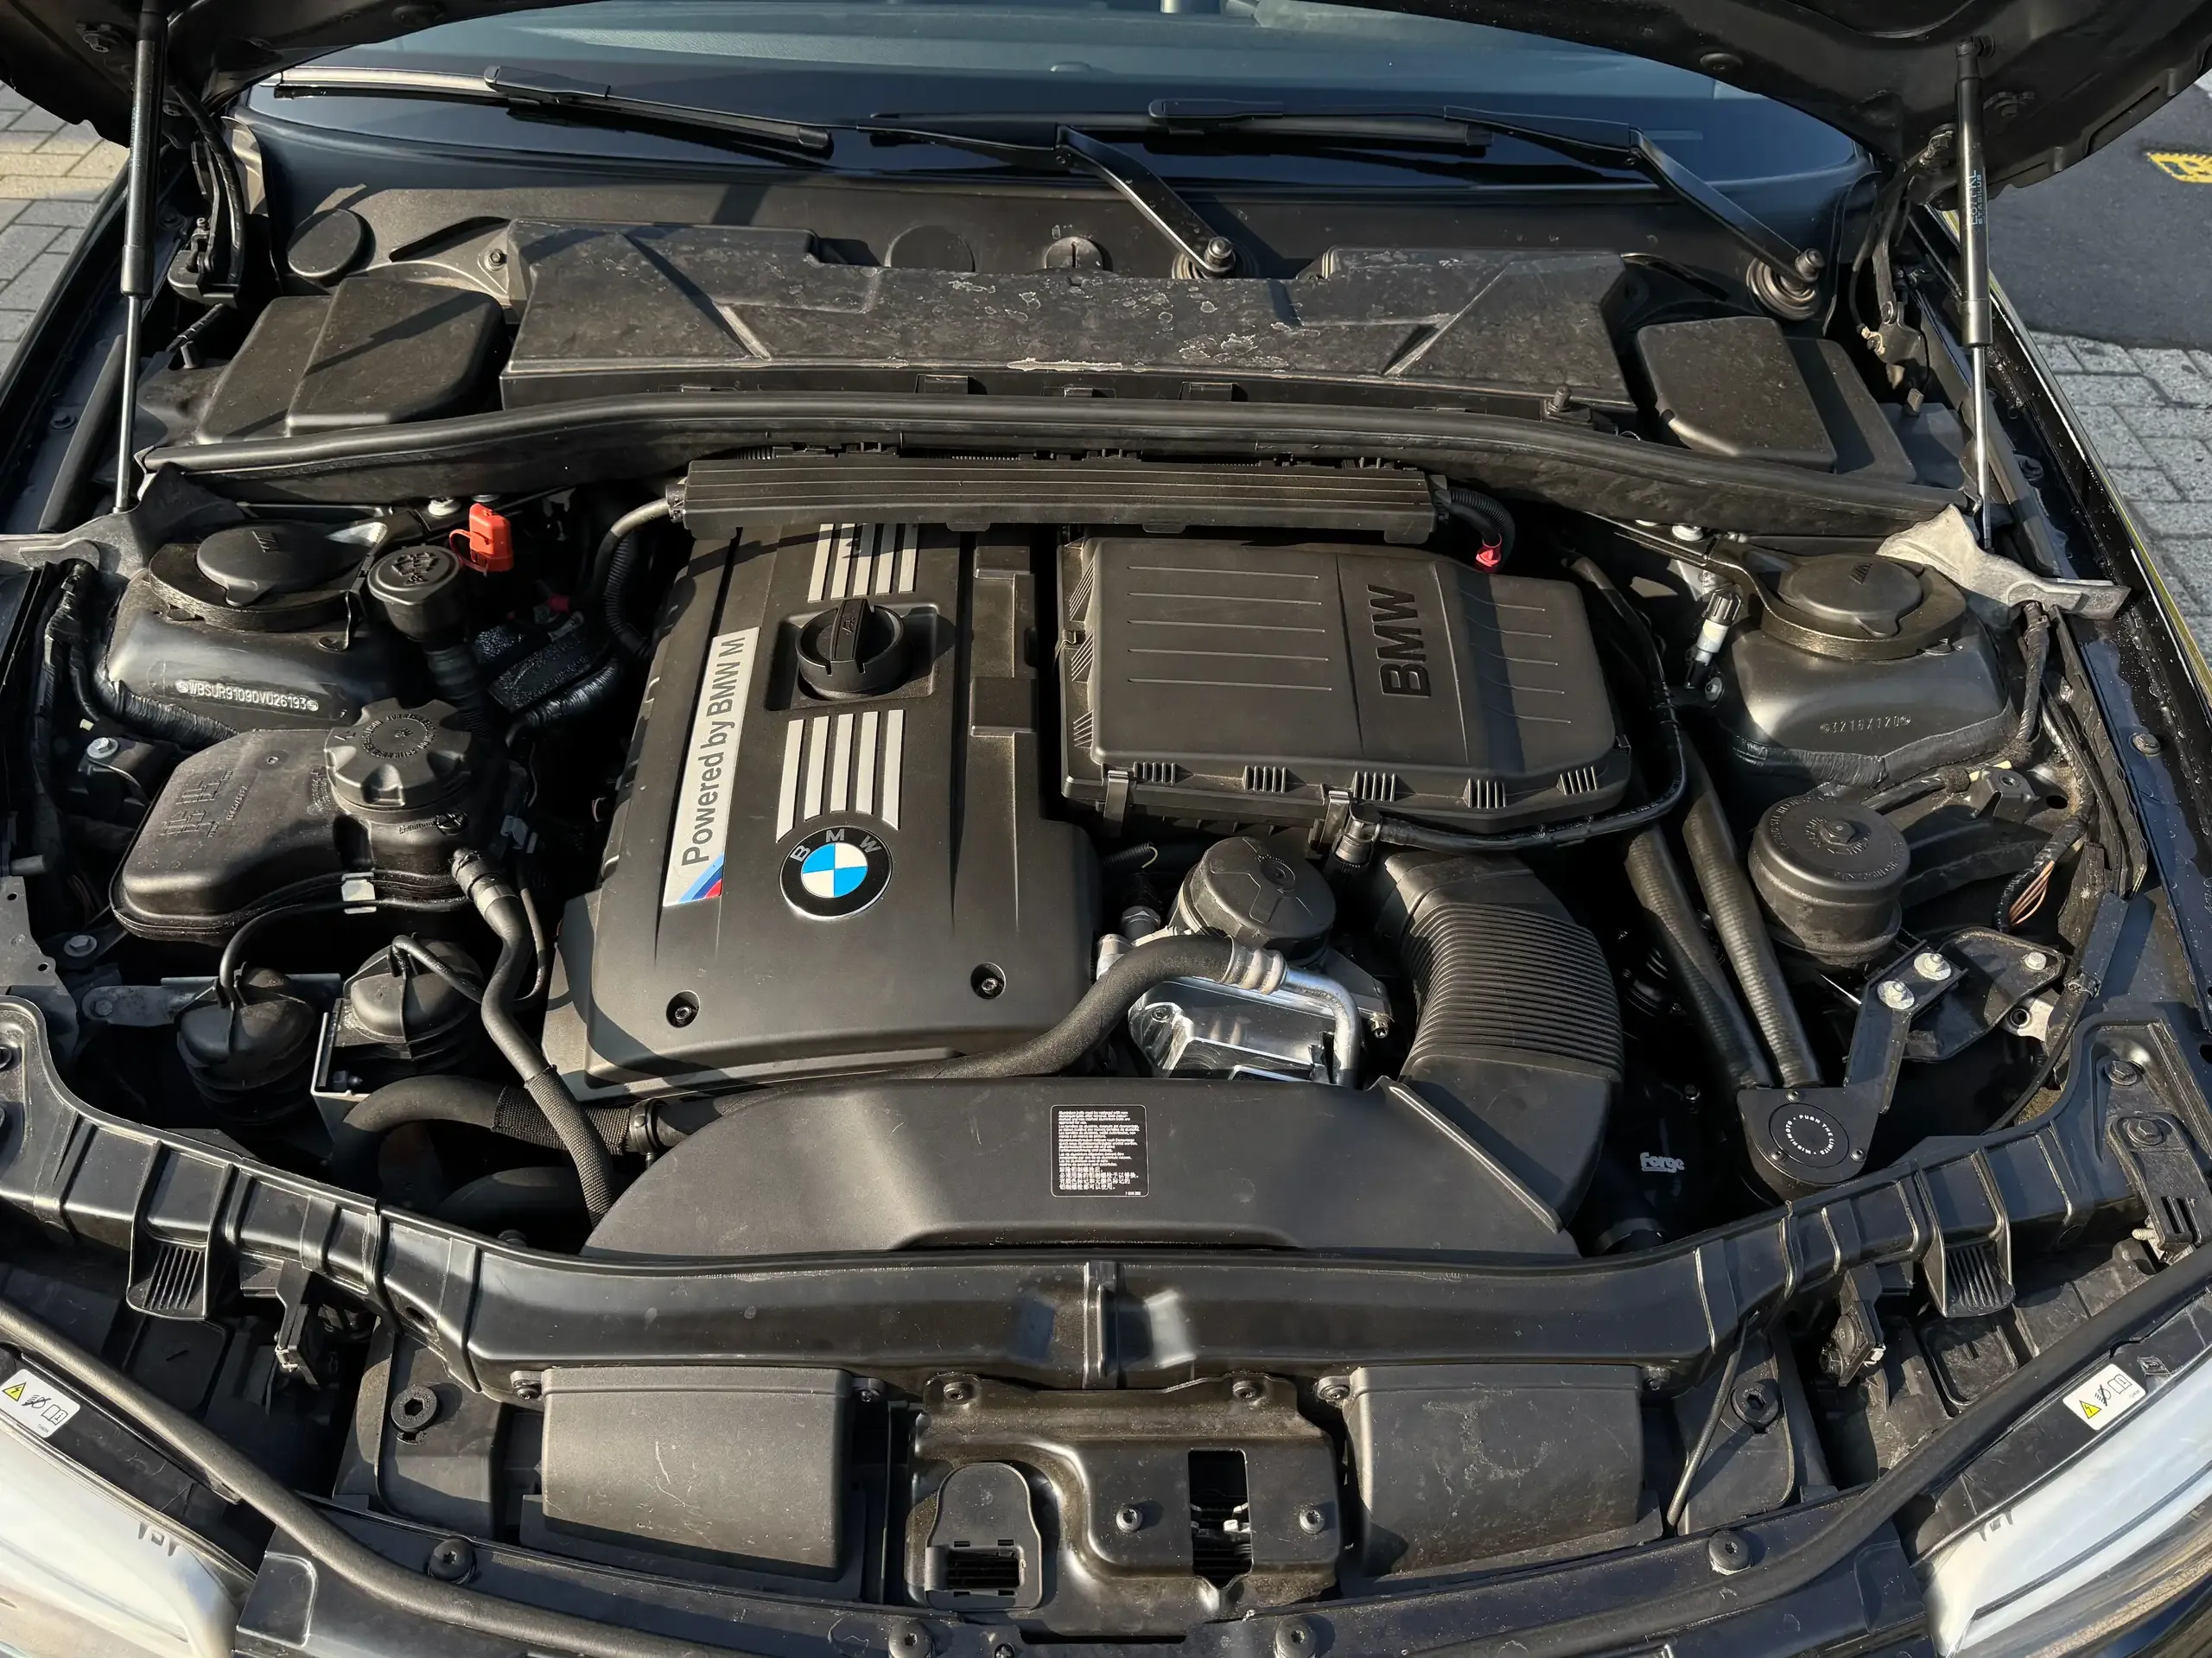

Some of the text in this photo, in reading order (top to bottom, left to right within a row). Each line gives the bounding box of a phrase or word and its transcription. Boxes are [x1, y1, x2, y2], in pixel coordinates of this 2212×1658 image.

[1366, 584, 1432, 698] BMW
[681, 638, 746, 866] Powered by BMW M
[790, 829, 881, 861] BMW
